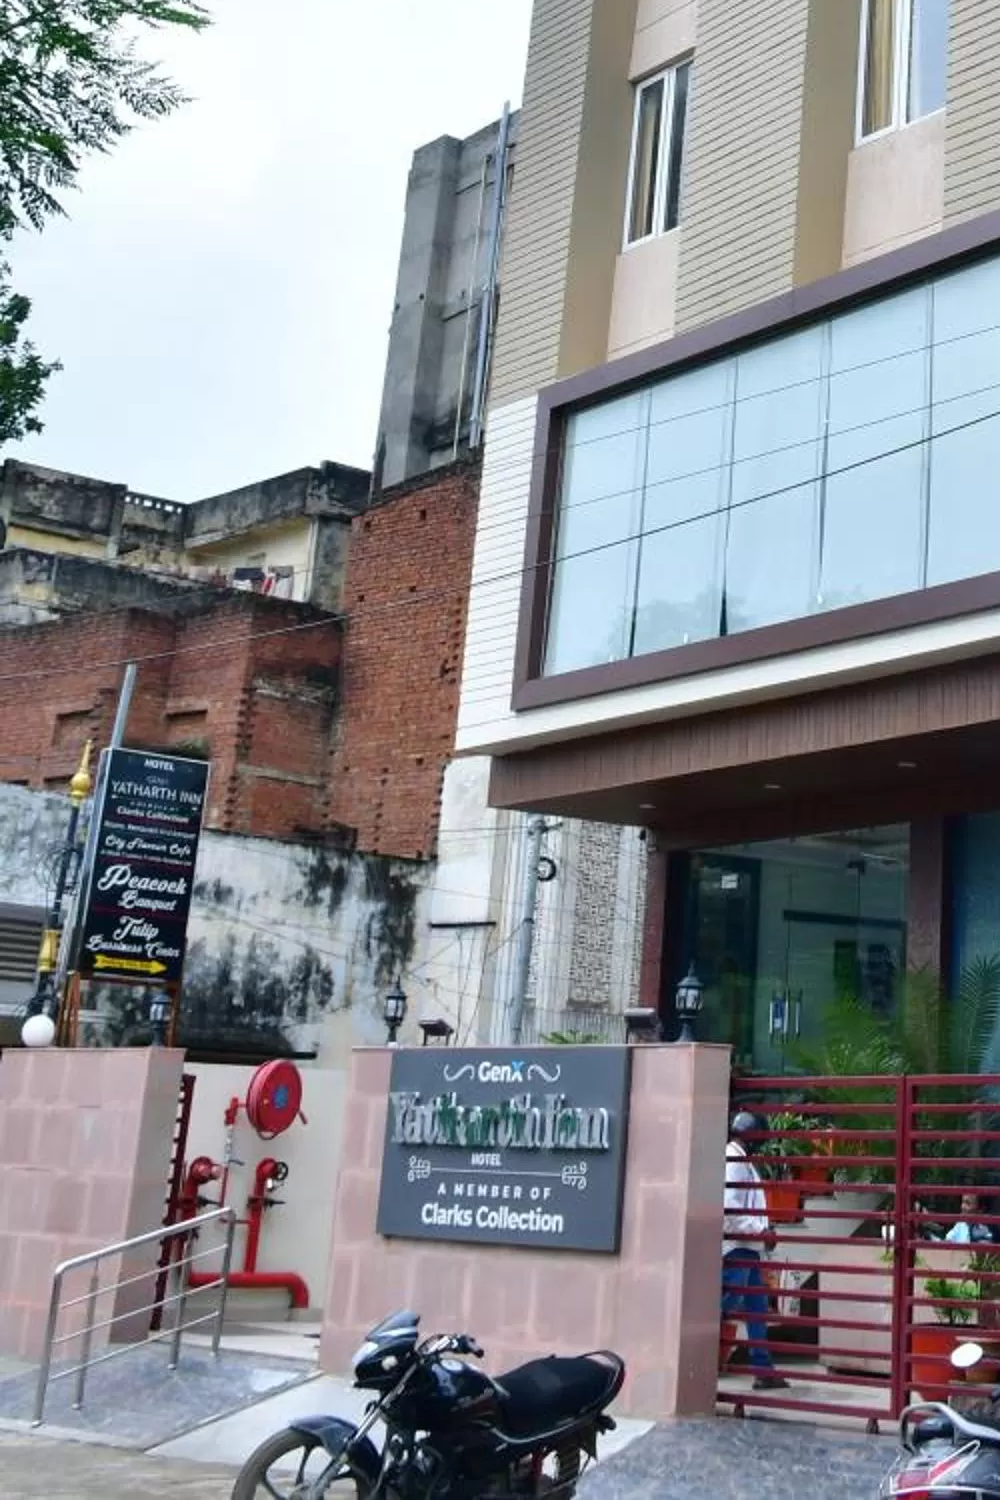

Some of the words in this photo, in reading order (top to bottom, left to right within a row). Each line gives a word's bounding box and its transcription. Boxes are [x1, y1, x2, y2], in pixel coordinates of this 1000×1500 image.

[144, 758, 175, 772] HOTEL
[111, 780, 177, 801] YATHARTH
[180, 790, 202, 805] INN
[98, 864, 187, 895] Peacock
[118, 889, 177, 912] Banquet
[113, 915, 159, 941] Tulip
[478, 1060, 525, 1082] GenX
[471, 1153, 502, 1167] HOTEL
[437, 1183, 447, 1196] A
[454, 1183, 522, 1199] MEMBER
[530, 1186, 552, 1200] OF
[421, 1203, 472, 1225] Clarks
[476, 1206, 564, 1233] Collection
